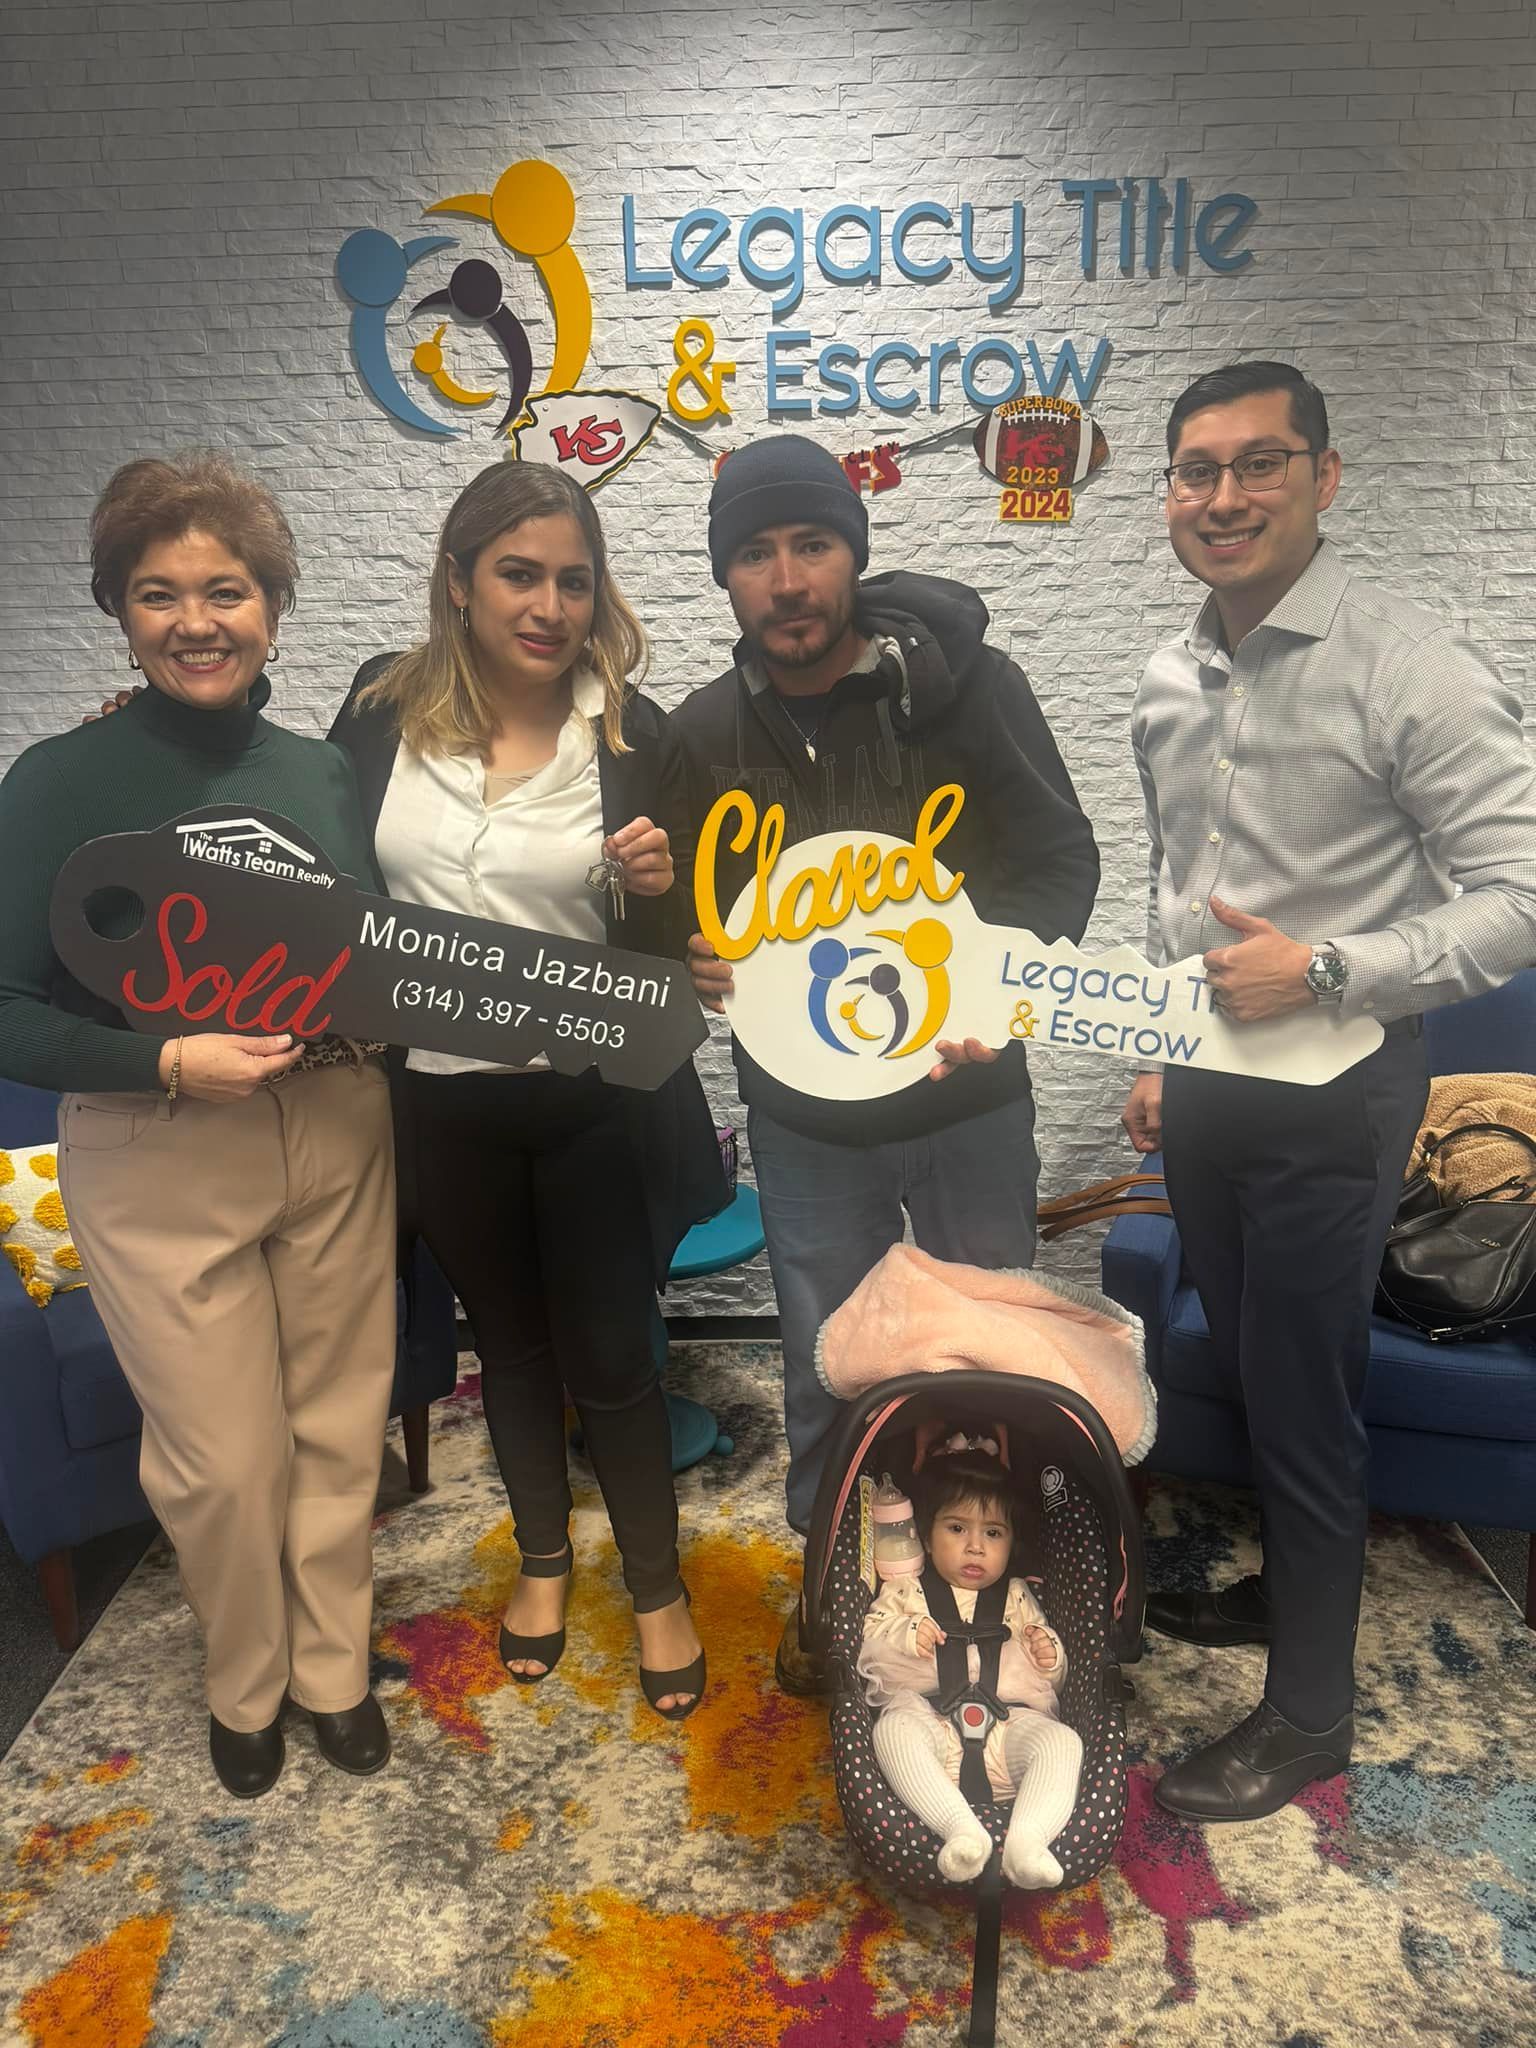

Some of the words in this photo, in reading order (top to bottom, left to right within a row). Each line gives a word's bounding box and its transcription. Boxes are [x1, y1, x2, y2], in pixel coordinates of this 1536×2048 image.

[622, 195, 1025, 314] Legacy
[1062, 177, 1260, 278] Title
[667, 319, 736, 420] &
[766, 329, 1112, 414] Escrow
[550, 414, 626, 466] KC
[847, 441, 902, 465] CITY
[1001, 488, 1070, 519] 2024
[1007, 465, 1060, 485] 2023
[189, 836, 242, 867] Watts
[244, 850, 296, 879] Team
[296, 868, 336, 890] Realty
[199, 831, 214, 842] The
[694, 783, 966, 961] Closed
[122, 892, 352, 1037] Sold
[359, 911, 506, 973] Monica
[522, 948, 671, 1008] Jazbani
[1001, 951, 1171, 1018] Legacy
[392, 978, 465, 1021] (314)
[476, 997, 532, 1028] 397
[555, 1012, 626, 1049] 5503
[1009, 999, 1041, 1039] &
[1050, 1009, 1203, 1062] Escrow
